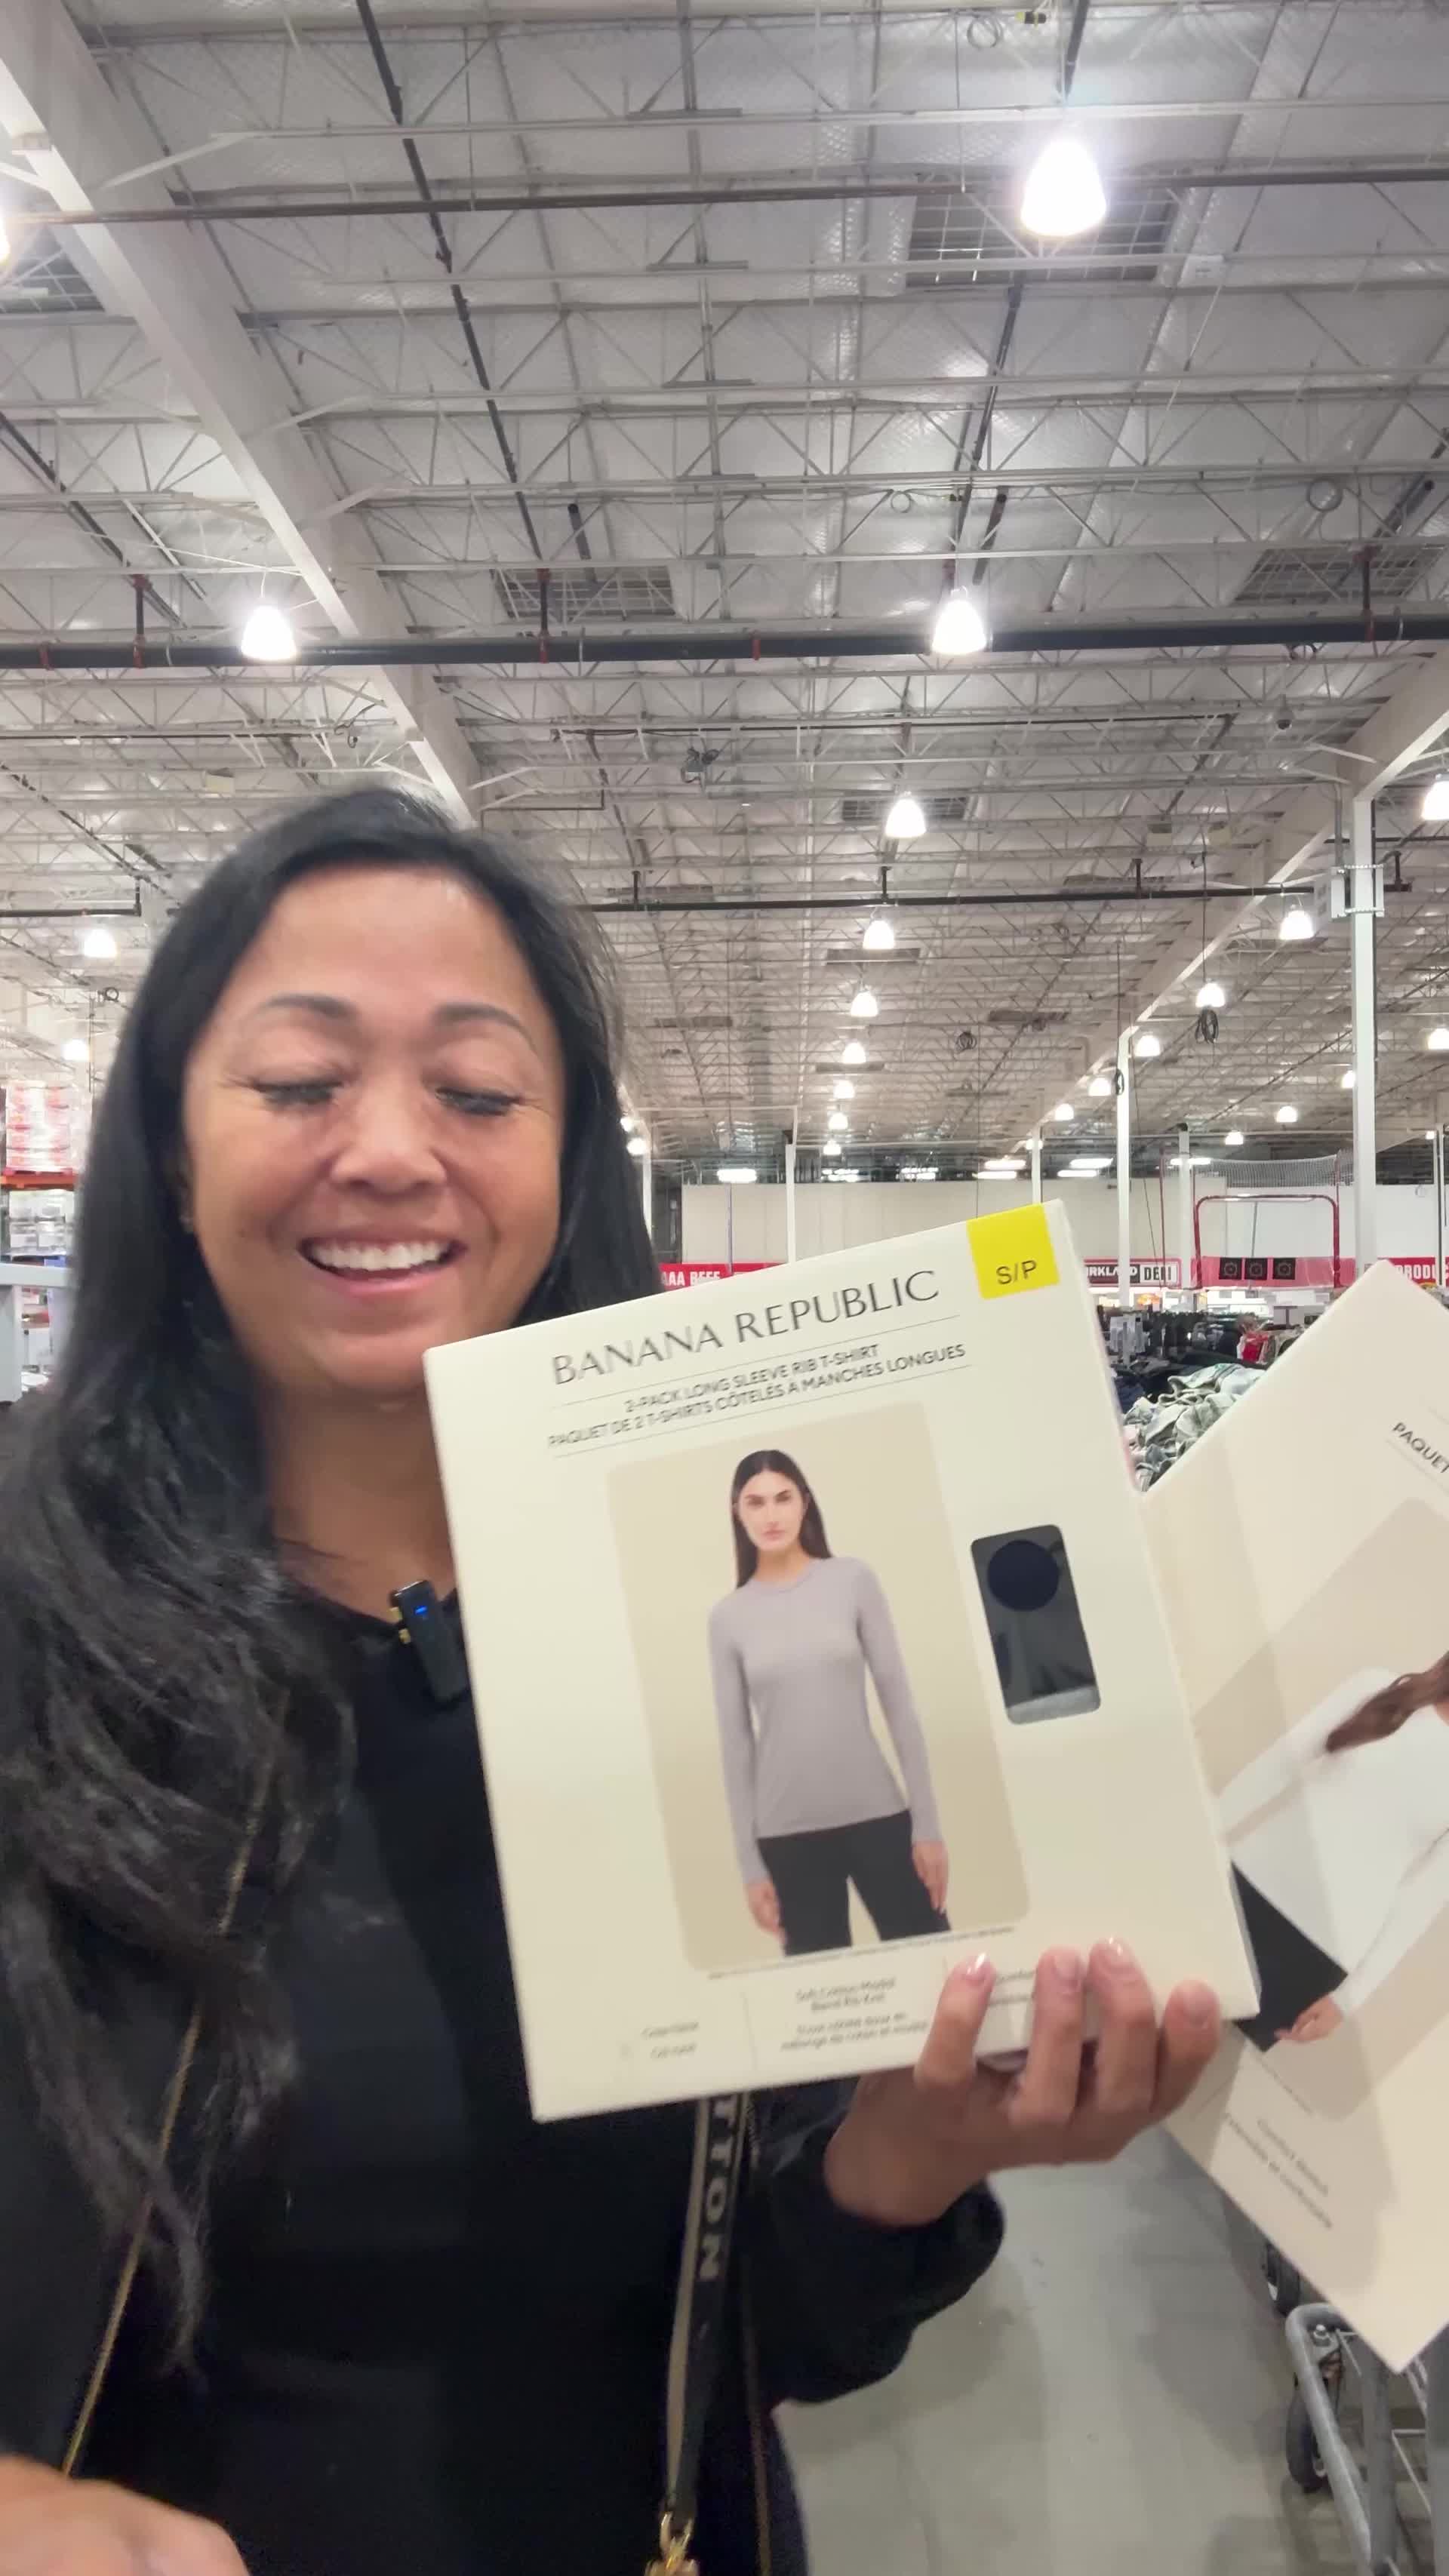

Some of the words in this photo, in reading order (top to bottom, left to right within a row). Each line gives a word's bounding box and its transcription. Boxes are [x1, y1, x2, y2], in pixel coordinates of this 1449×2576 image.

[995, 1259, 1038, 1285] S/P
[552, 1323, 723, 1385] BANANA
[734, 1270, 940, 1343] REPUBLIC
[548, 1423, 608, 1447] PAQUET
[612, 1418, 631, 1435] DE
[635, 1416, 645, 1429] 2
[647, 1400, 712, 1426] T-SHIRTS
[802, 1362, 884, 1391] MANCHES
[887, 1344, 966, 1373] LONGUES
[623, 1389, 679, 1413] 2-PACK
[685, 1377, 731, 1399] LONG
[733, 1365, 789, 1388] SLEEVE
[792, 1357, 818, 1374] RIB
[820, 1344, 879, 1367] T-SHIRT
